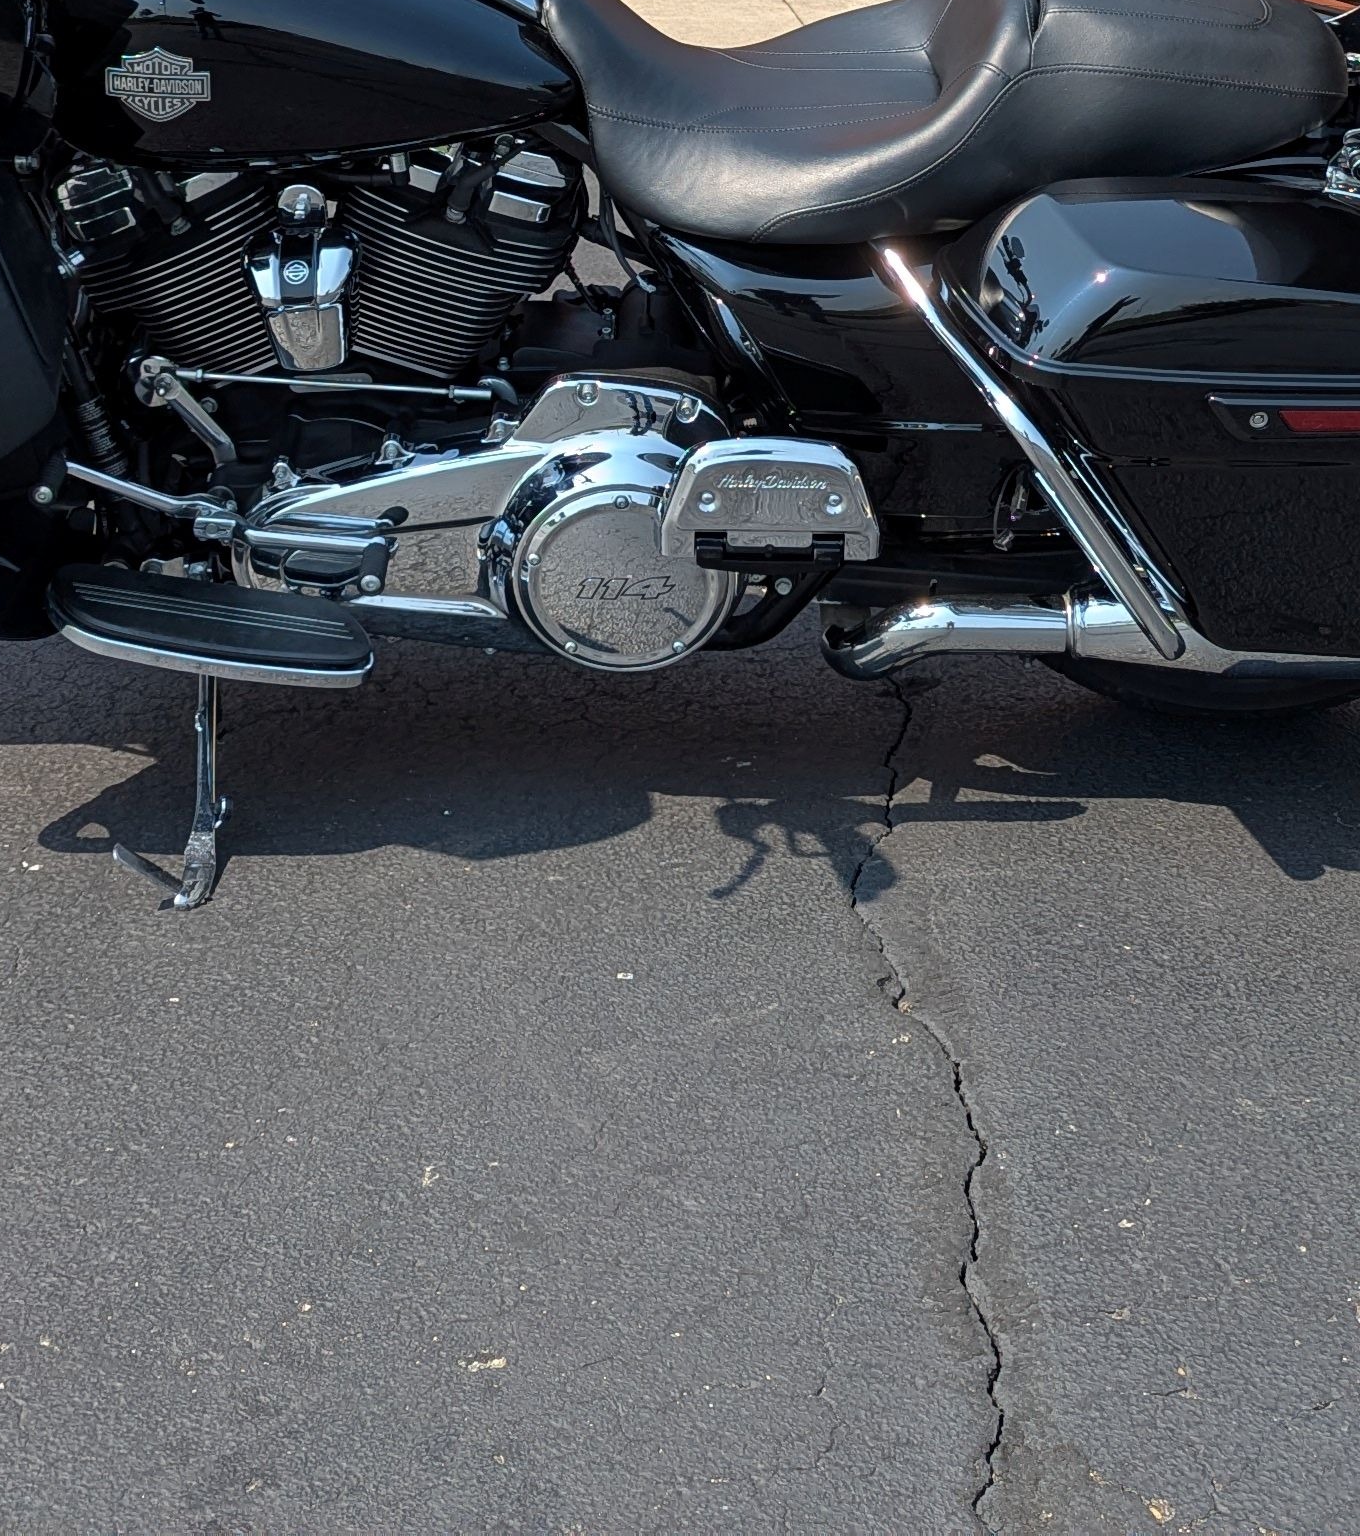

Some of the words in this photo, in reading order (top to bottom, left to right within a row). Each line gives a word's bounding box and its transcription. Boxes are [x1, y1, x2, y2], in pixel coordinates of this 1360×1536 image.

[133, 57, 180, 75] MOTOR
[113, 76, 203, 94] HARLEY-DAVIDSON
[134, 96, 182, 115] CYCLES
[576, 576, 677, 601] 114
